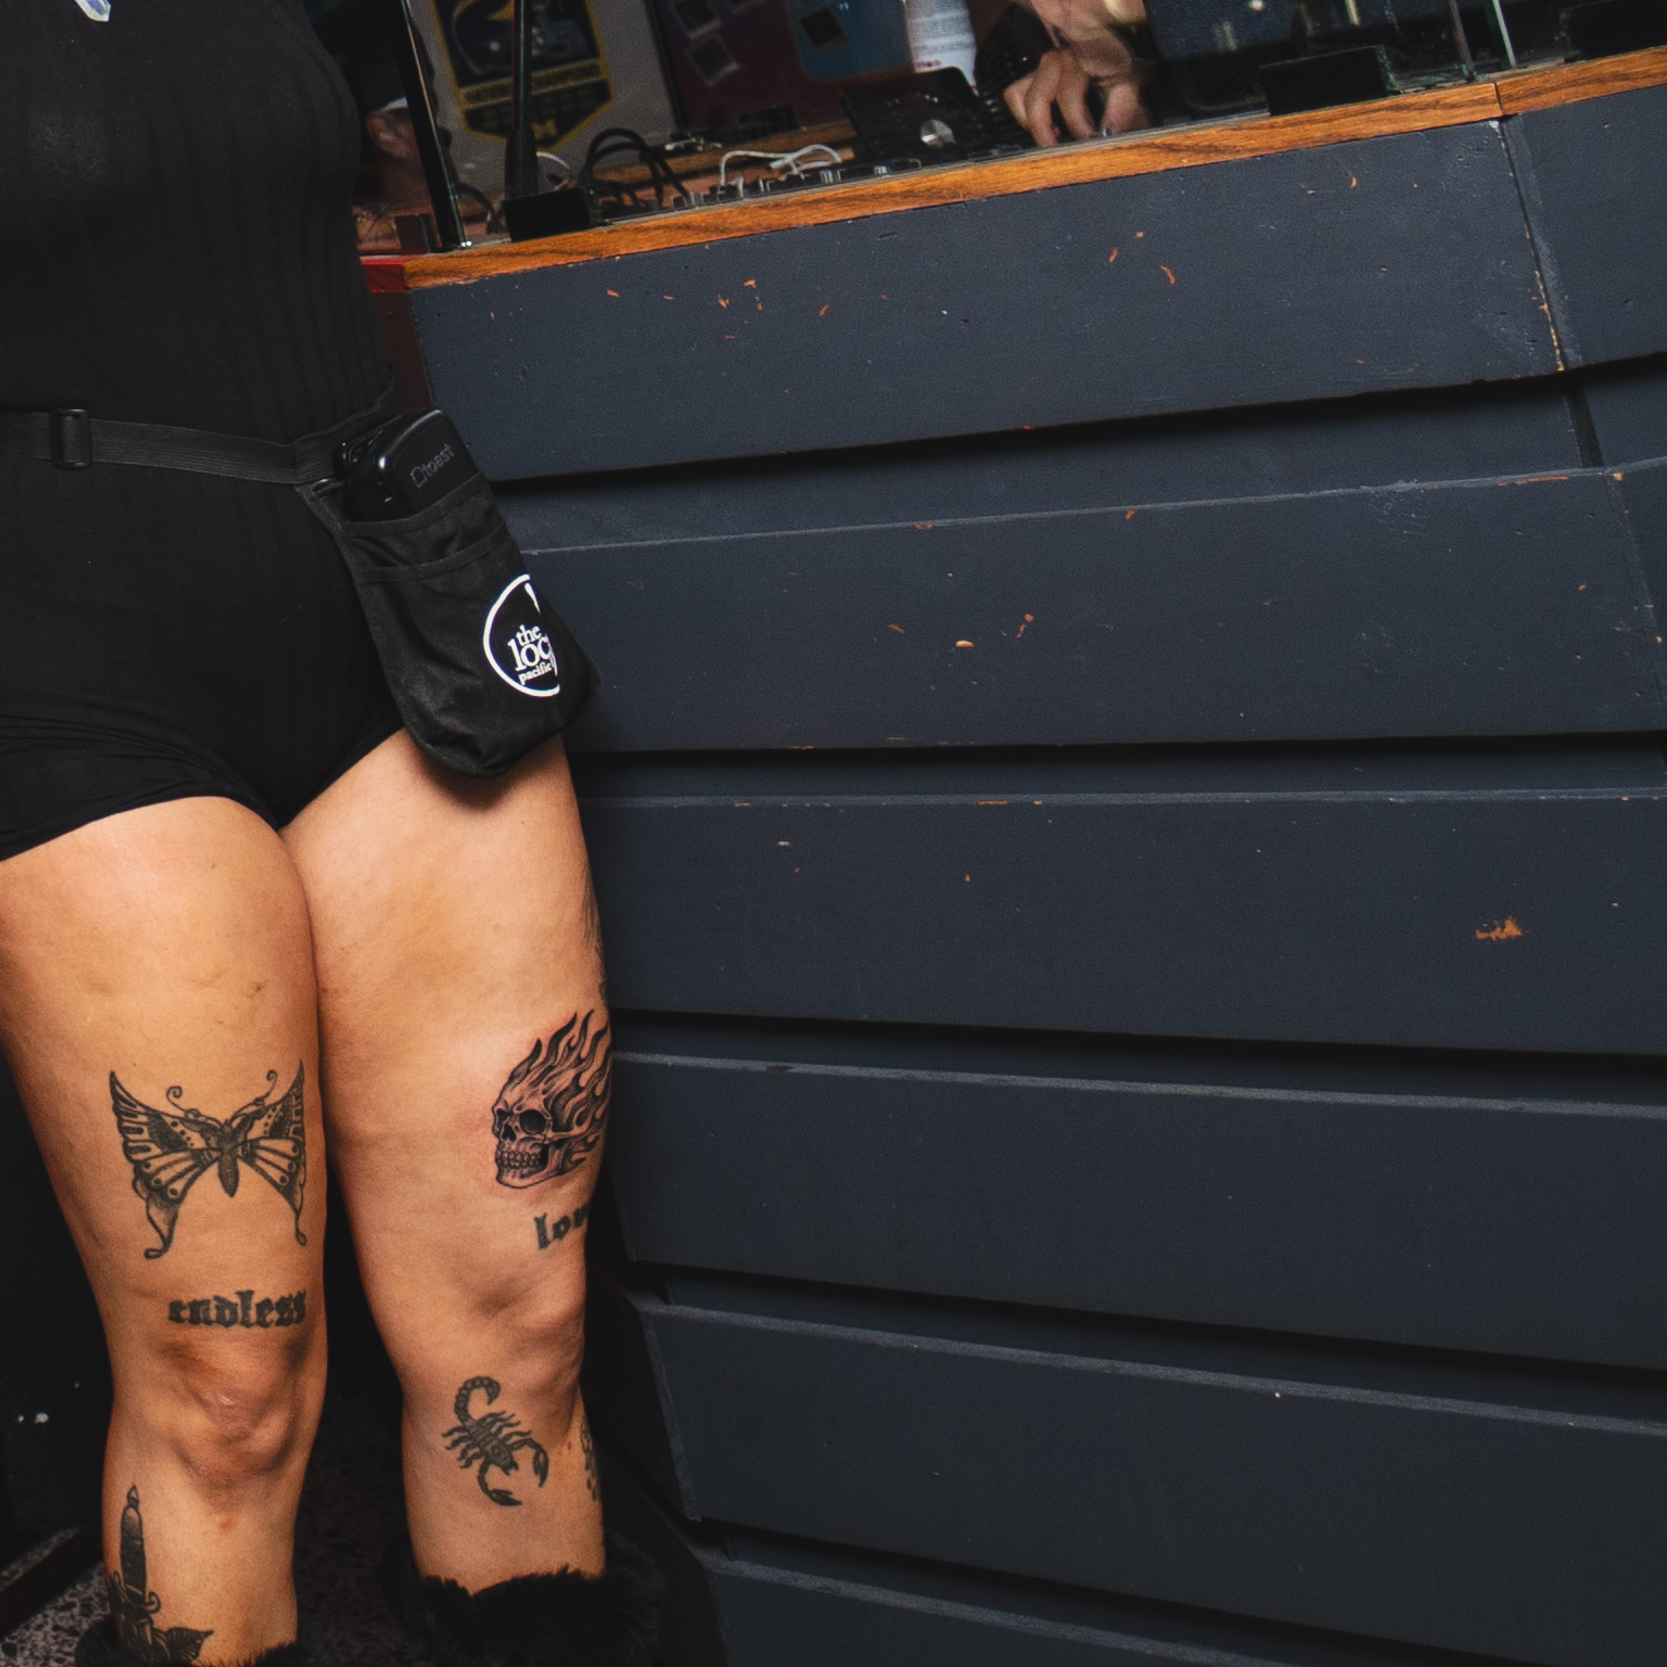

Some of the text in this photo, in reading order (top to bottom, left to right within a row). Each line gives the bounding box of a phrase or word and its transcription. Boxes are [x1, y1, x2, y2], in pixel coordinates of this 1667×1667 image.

[422, 444, 455, 477] toast
[515, 624, 542, 647] the
[168, 1289, 307, 1329] endless
